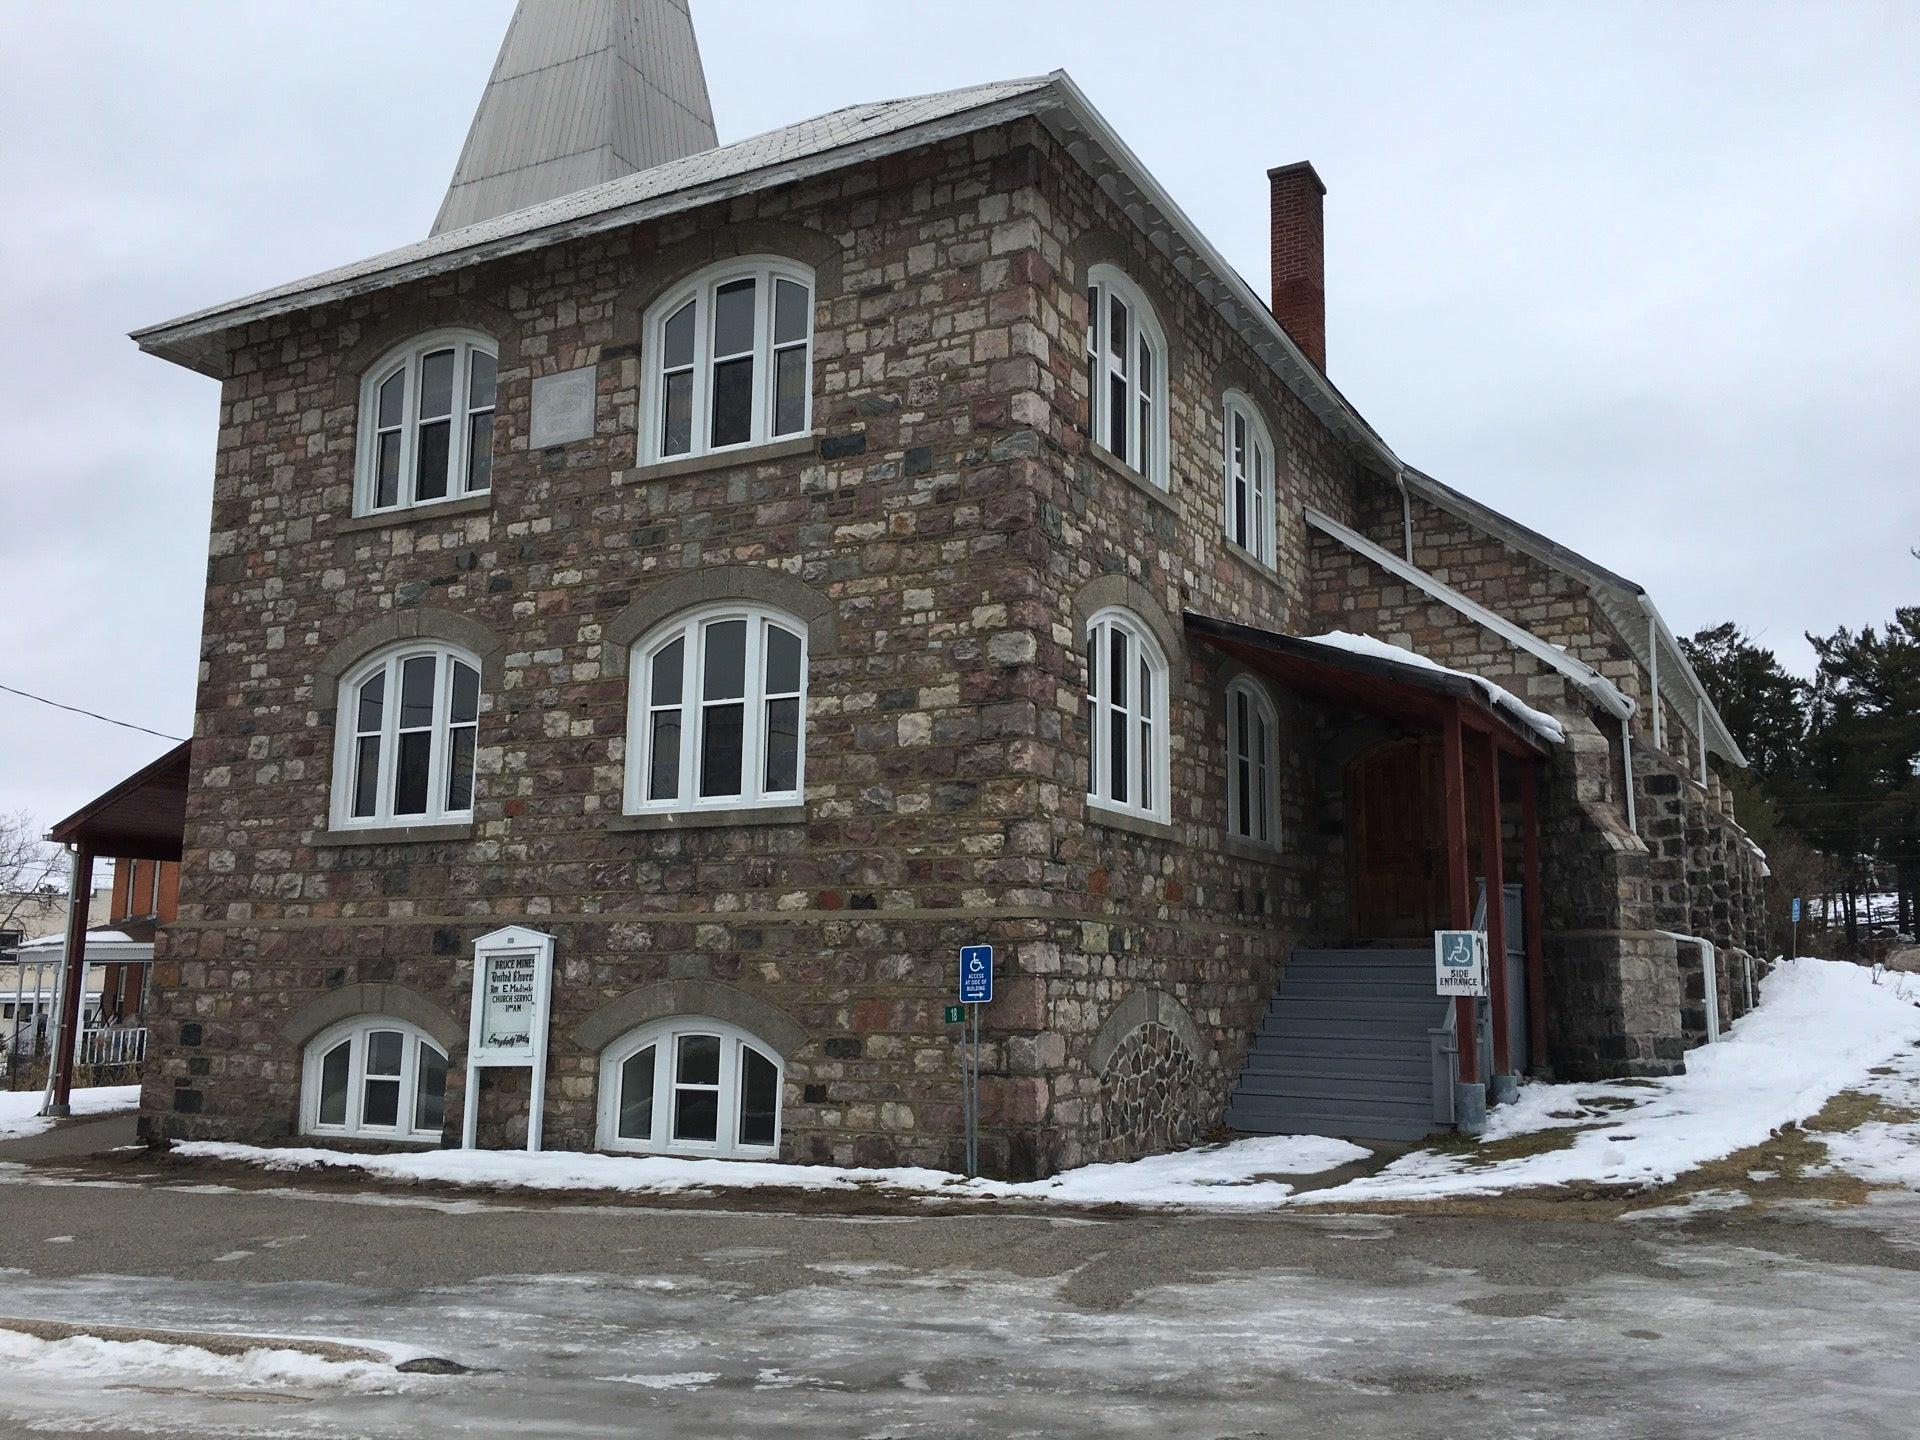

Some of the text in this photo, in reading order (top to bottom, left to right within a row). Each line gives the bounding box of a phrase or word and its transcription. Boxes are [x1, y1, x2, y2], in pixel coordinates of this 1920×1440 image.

[495, 960, 515, 970] BRUCE
[491, 971, 511, 982] United
[1451, 970, 1468, 978] SIDE
[1440, 978, 1477, 986] ENTRANCE
[502, 984, 508, 992] E
[492, 995, 512, 1003] CHURCH
[950, 1008, 958, 1021] 18
